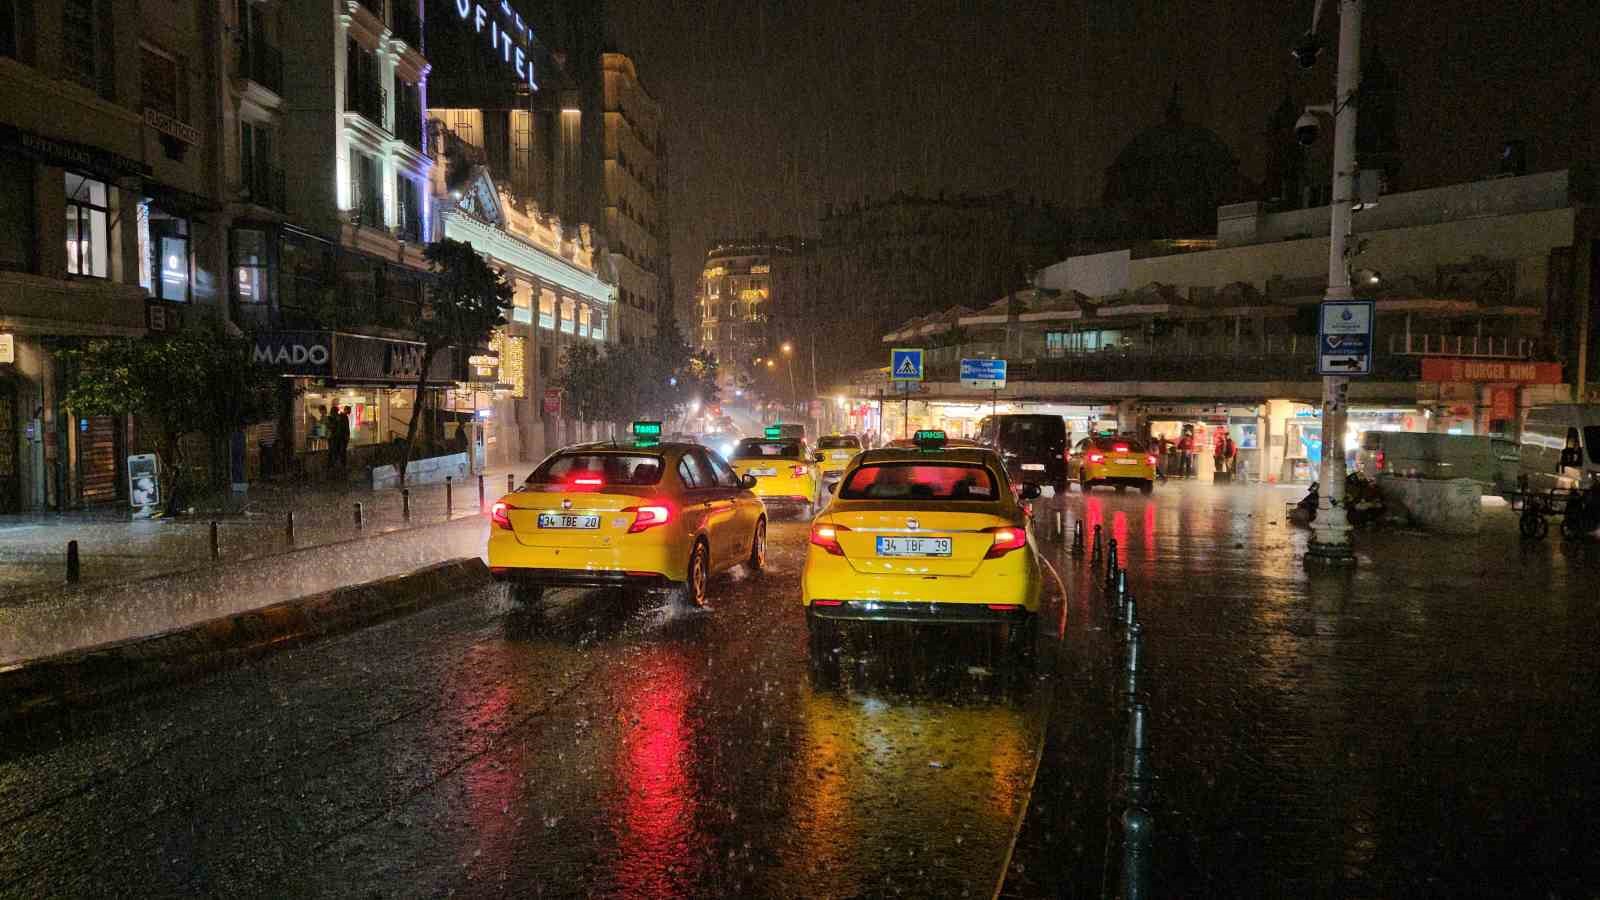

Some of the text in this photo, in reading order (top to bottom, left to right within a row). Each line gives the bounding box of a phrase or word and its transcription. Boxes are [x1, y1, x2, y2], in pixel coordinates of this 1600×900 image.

[253, 344, 329, 365] MADO
[1464, 363, 1537, 380] BURGER KING
[635, 425, 660, 433] TAKSI
[543, 516, 597, 528] 34 TBE 20
[884, 539, 897, 552] 34
